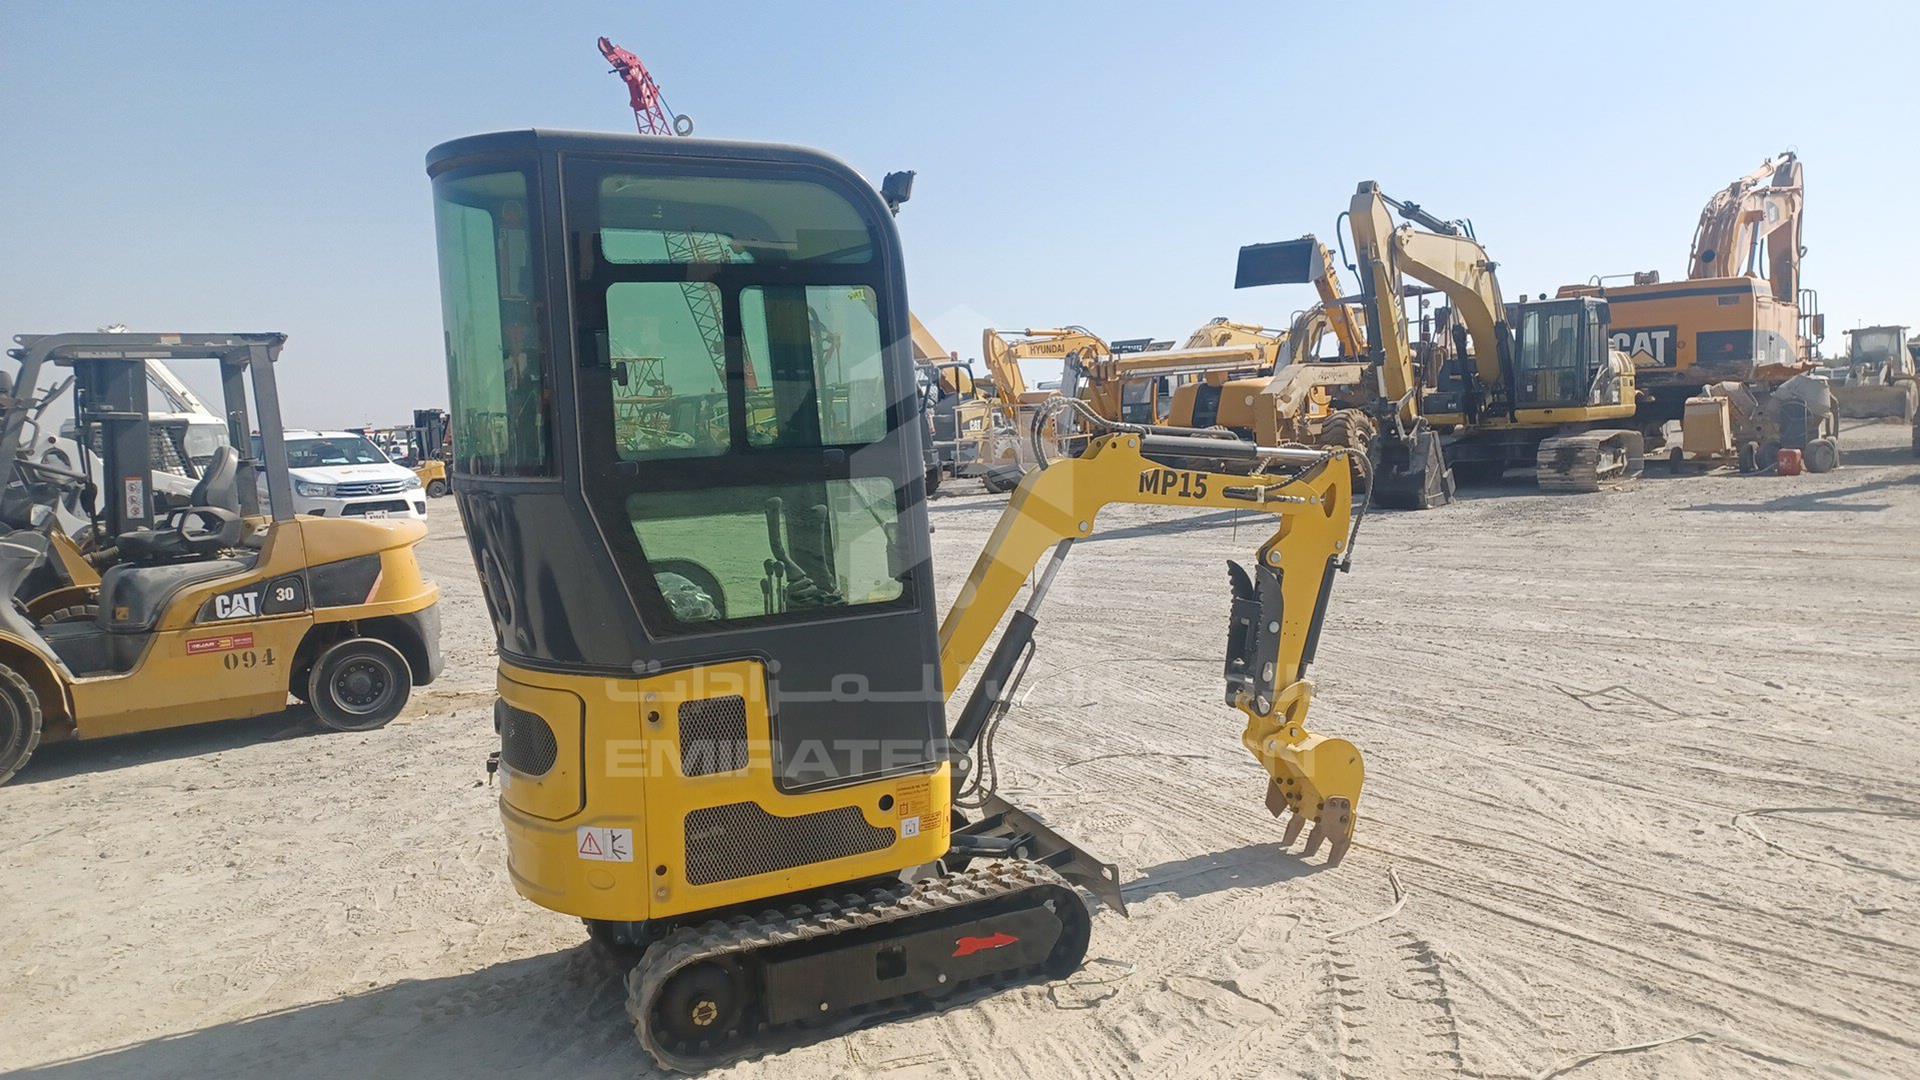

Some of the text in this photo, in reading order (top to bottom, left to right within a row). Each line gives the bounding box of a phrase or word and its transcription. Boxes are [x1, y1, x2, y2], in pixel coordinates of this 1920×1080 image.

[1030, 344, 1065, 355] HYUNDAI
[1612, 330, 1670, 366] CAT
[1139, 469, 1207, 499] MP15
[215, 587, 294, 619] CAT 30
[223, 648, 276, 670] 094
